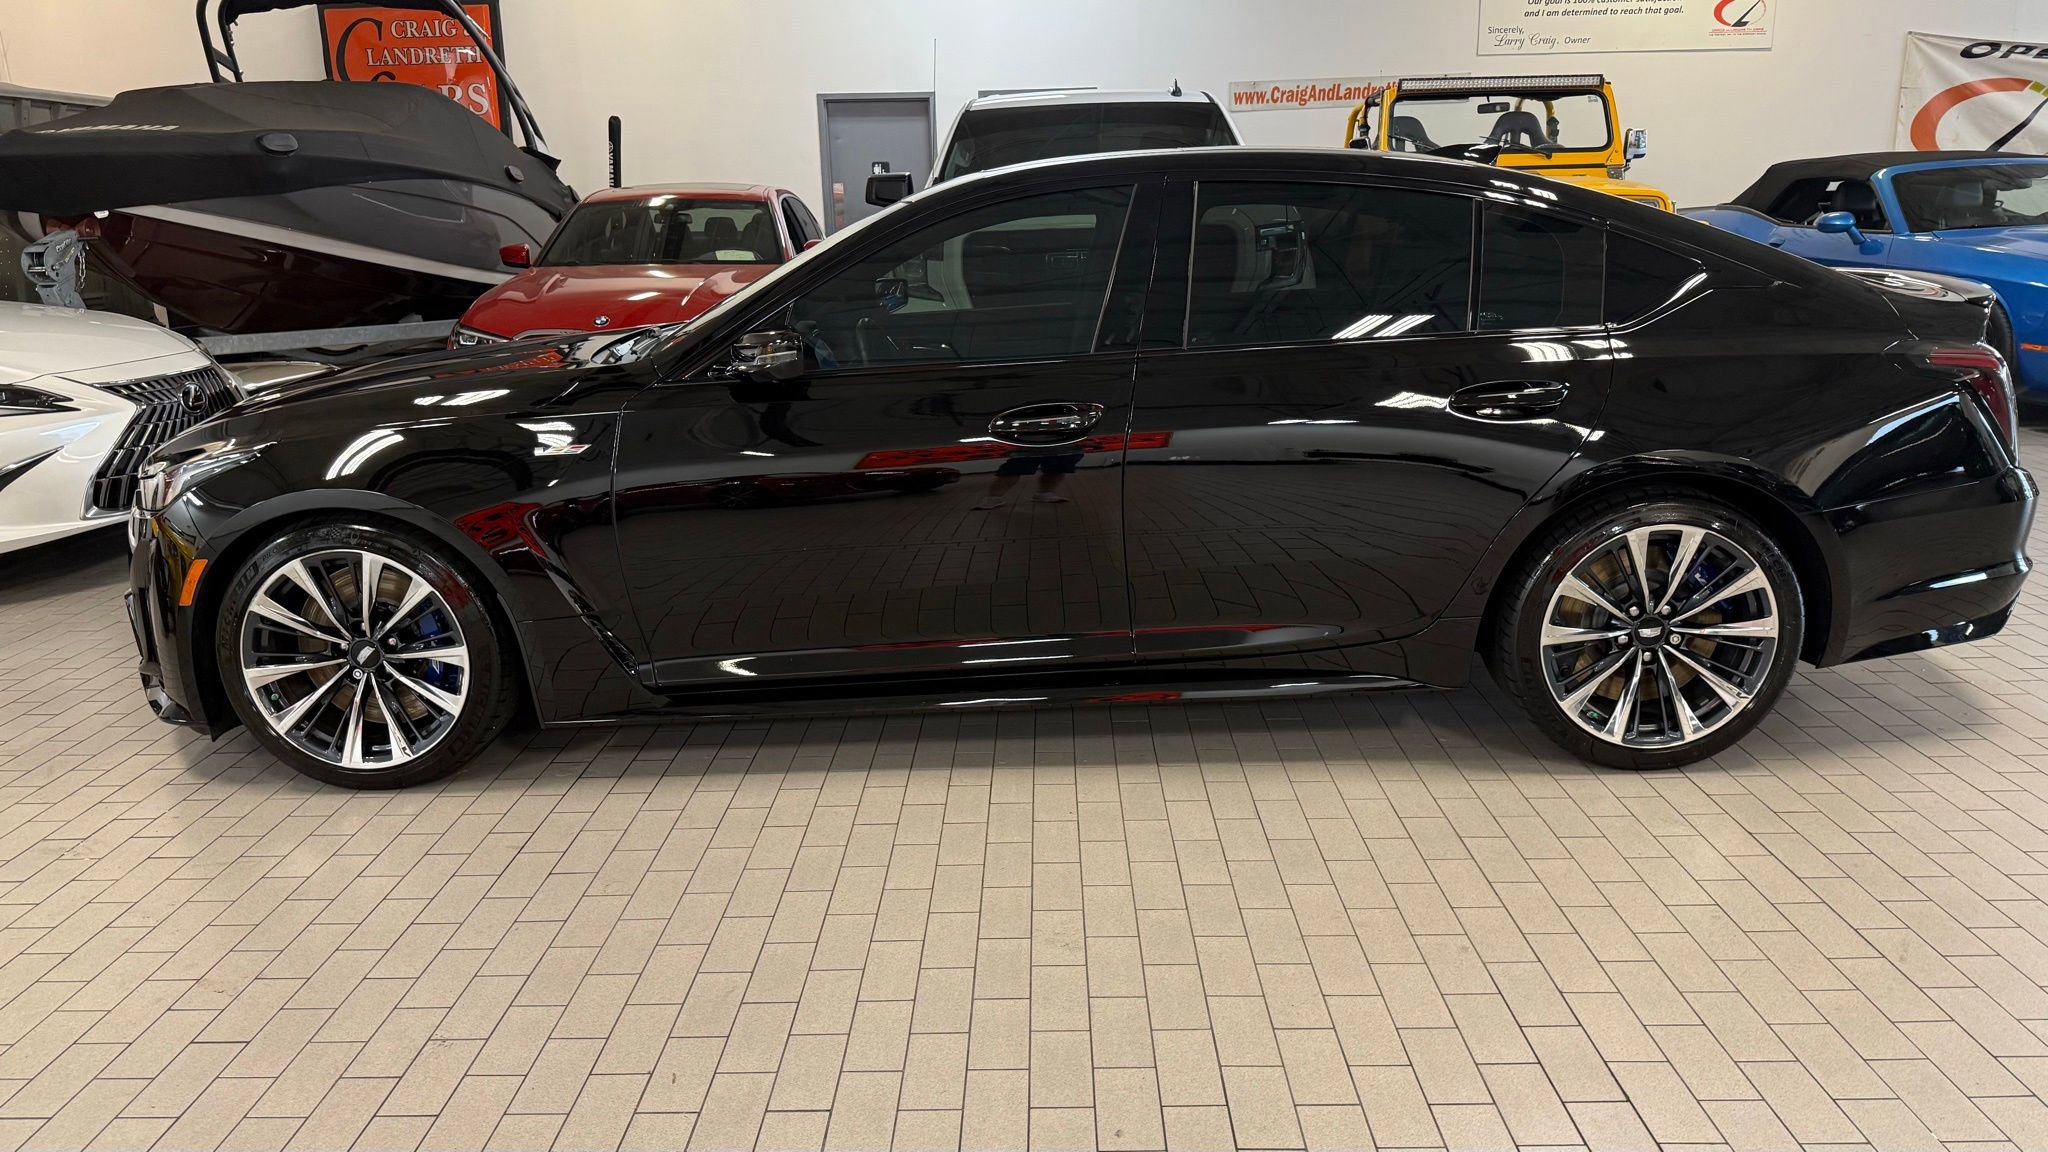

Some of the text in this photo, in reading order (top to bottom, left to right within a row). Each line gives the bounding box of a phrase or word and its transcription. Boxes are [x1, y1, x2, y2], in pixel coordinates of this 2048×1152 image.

[1524, 9, 1540, 17] and
[1561, 8, 1608, 17] determined
[1619, 6, 1643, 15] reach
[1645, 6, 1662, 14] that
[1664, 5, 1684, 15] goal.
[390, 18, 457, 38] CRAIG
[1487, 25, 1525, 35] Sincerely,
[1494, 34, 1526, 51] Larry
[1564, 36, 1592, 45] Owner
[366, 45, 484, 66] LANDRETH
